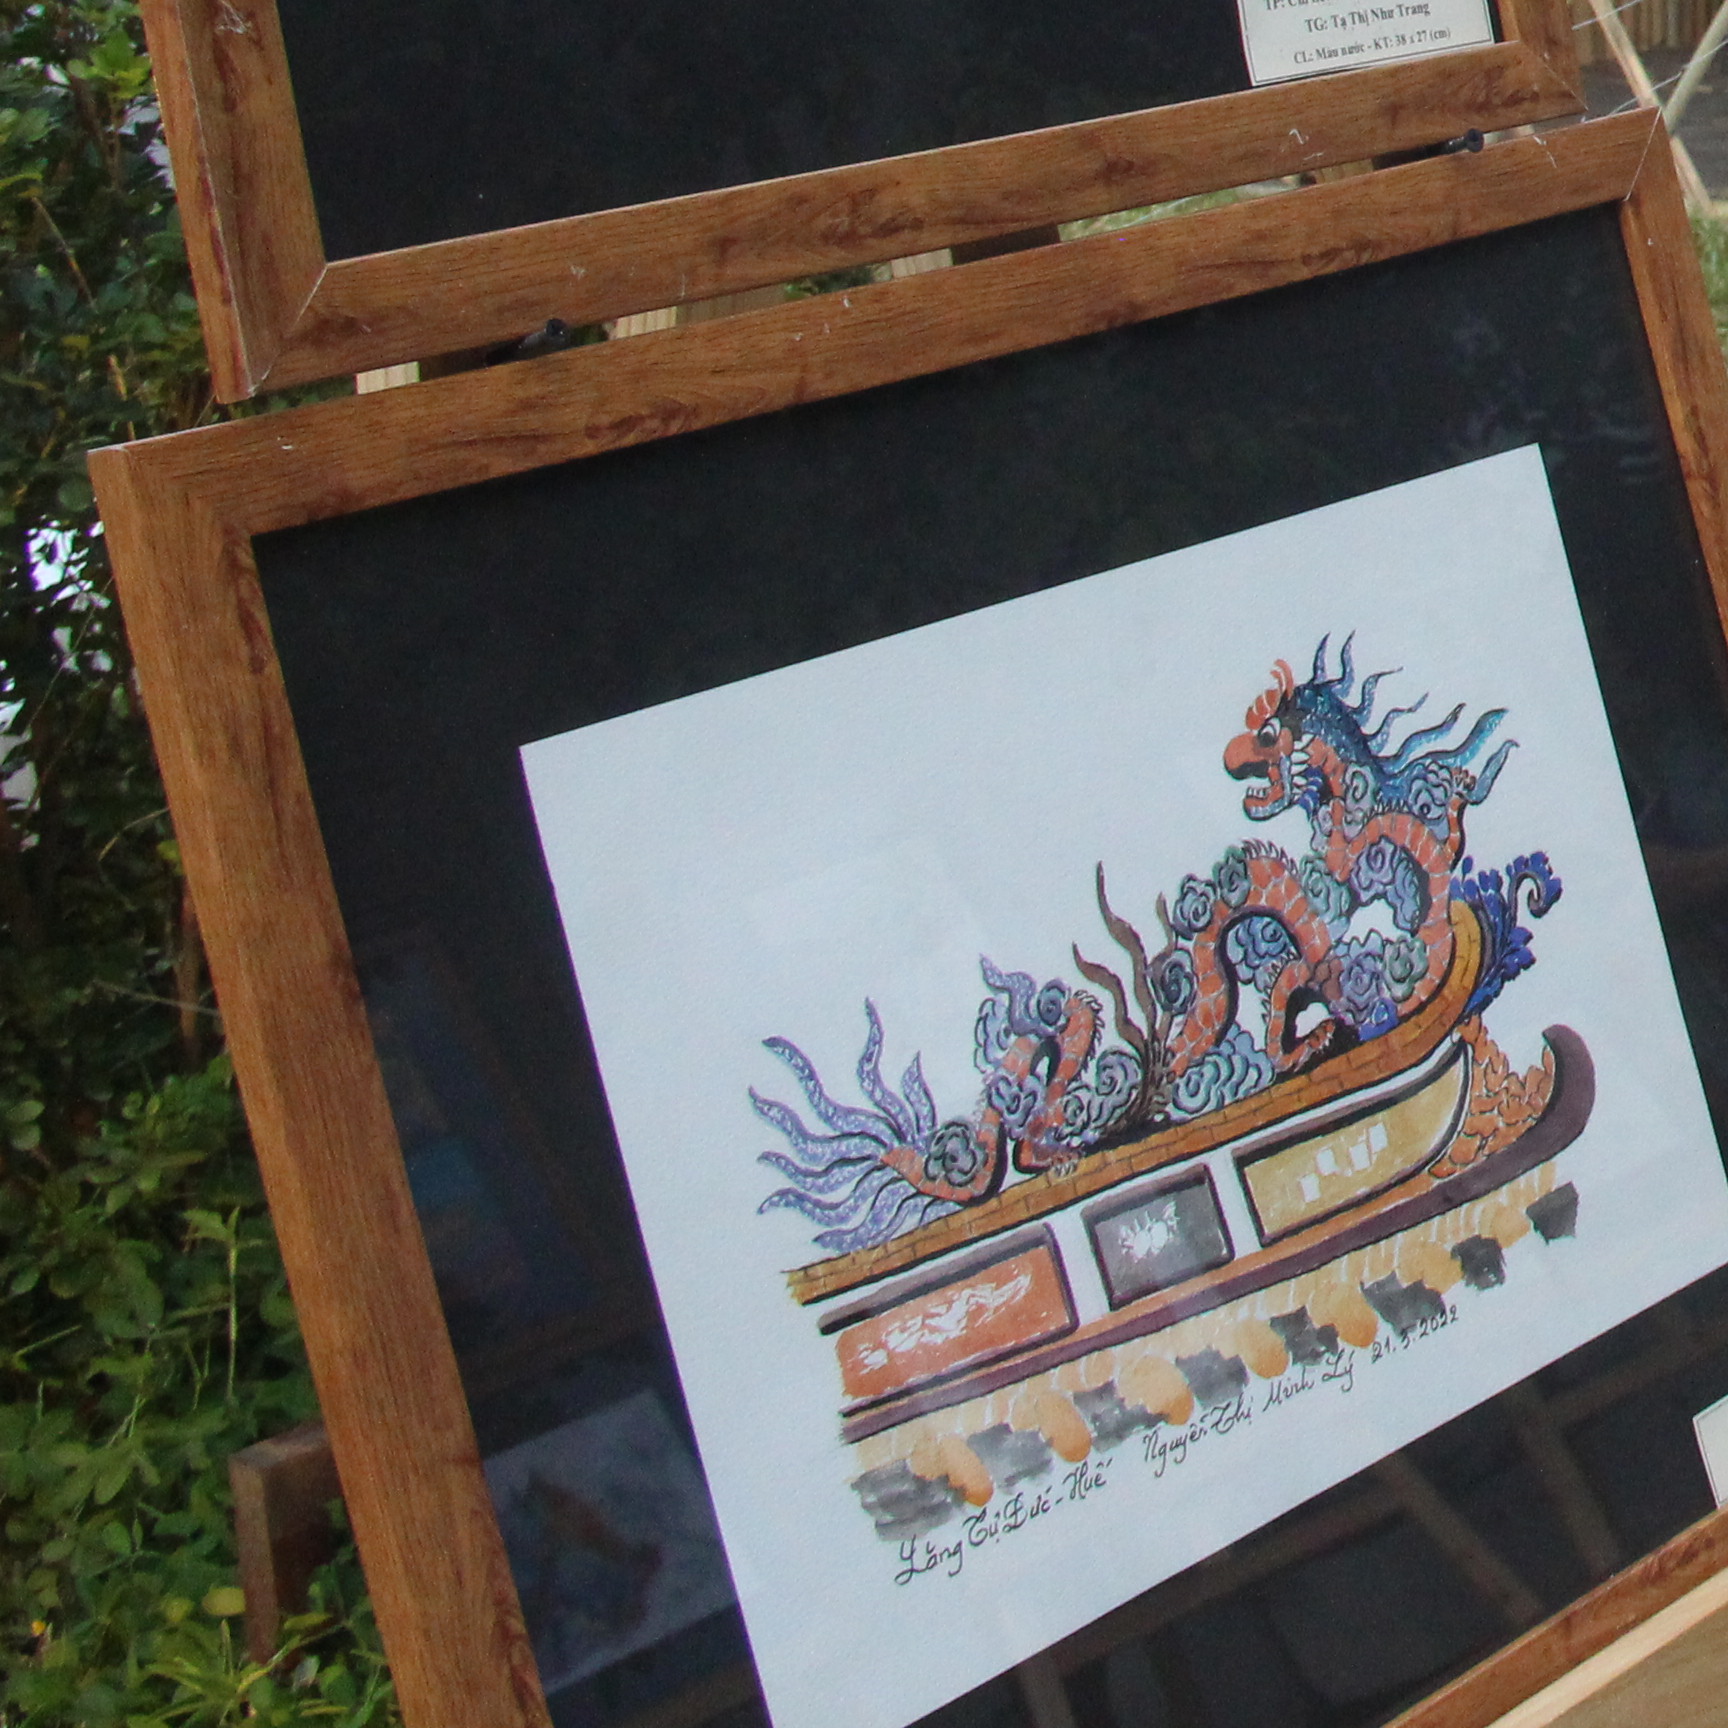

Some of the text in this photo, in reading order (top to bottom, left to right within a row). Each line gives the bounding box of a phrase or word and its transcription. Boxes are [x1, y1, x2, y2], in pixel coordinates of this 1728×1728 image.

[1304, 16, 1329, 33] TG:
[1395, 2, 1431, 18] Trang
[1415, 29, 1428, 43] 27
